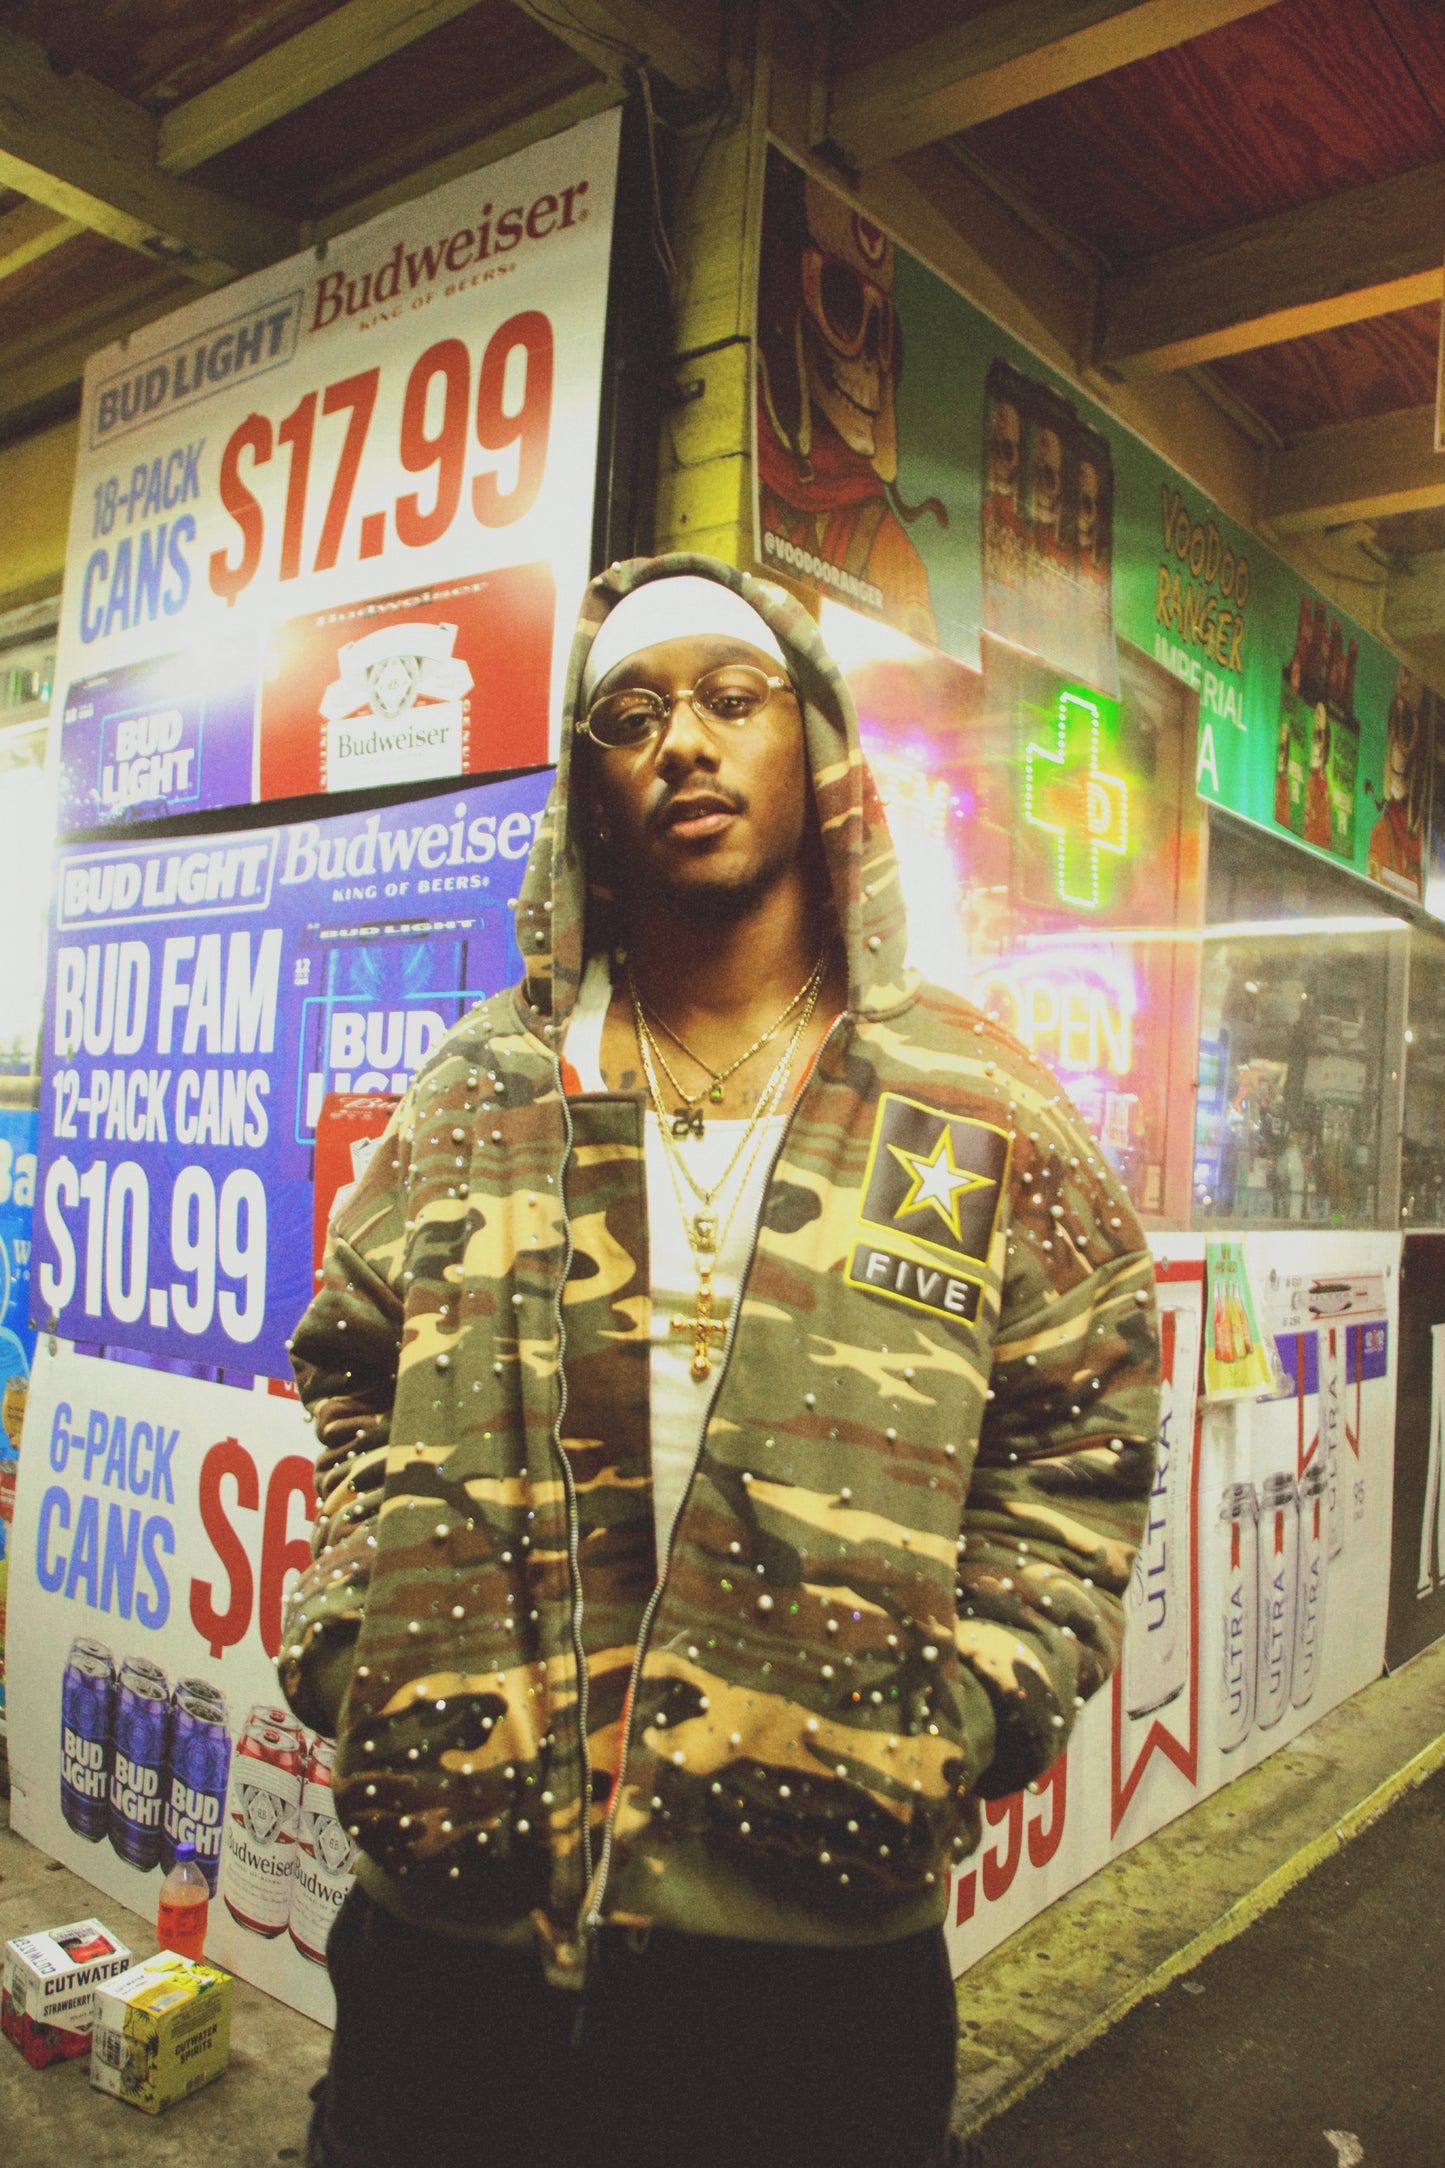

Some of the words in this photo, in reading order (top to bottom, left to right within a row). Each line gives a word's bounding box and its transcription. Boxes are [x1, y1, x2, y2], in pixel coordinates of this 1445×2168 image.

[308, 181, 590, 333] Budweiser
[411, 294, 435, 311] OF
[445, 265, 508, 297] BEERS
[97, 365, 169, 433] BUD
[172, 307, 293, 400] LIGHT
[92, 437, 206, 540] 18-PACK
[208, 310, 554, 608] $17.99
[80, 513, 197, 645] CANS
[1161, 482, 1250, 609] VOODOO
[1156, 563, 1243, 676] RANGER
[116, 709, 184, 762] BUD
[338, 725, 450, 759] Budweiser
[102, 748, 195, 803] LIGHT
[64, 862, 142, 917] BUD
[142, 845, 268, 908] LIGHT
[333, 885, 377, 902] KING
[385, 882, 410, 897] OF
[418, 874, 482, 894] BEERS
[319, 925, 381, 939] BUD
[384, 919, 476, 934] LIGHT
[55, 941, 151, 1056] BUD
[157, 928, 284, 1055] FAM
[972, 974, 1132, 1076] OPEN
[329, 1010, 449, 1069] BUD
[52, 1067, 168, 1144] 12-PACK
[177, 1069, 271, 1147] CANS
[39, 1155, 268, 1344] $10.99
[865, 1251, 969, 1313] FIVE
[50, 1402, 180, 1505] 6-PACK
[36, 1485, 176, 1631] CANS
[1147, 1411, 1173, 1633] ULTRA
[1230, 1584, 1243, 1716] ULTRA
[1270, 1569, 1285, 1695] ULTRA
[1303, 1555, 1320, 1675] ULTRA
[61, 1751, 108, 1799] LIGHT
[65, 1727, 104, 1771] BUD
[115, 1752, 159, 1798] BUD
[110, 1775, 162, 1826] LIGHT
[164, 1801, 222, 1856] LIGHT
[171, 1778, 220, 1826] BUD
[944, 1750, 1068, 1928] .99
[44, 1995, 91, 2016] STRAWBERRY
[45, 1959, 130, 1996] CUTWATER
[175, 2024, 218, 2056] CUTWATER
[180, 2038, 213, 2064] SPIRITS
